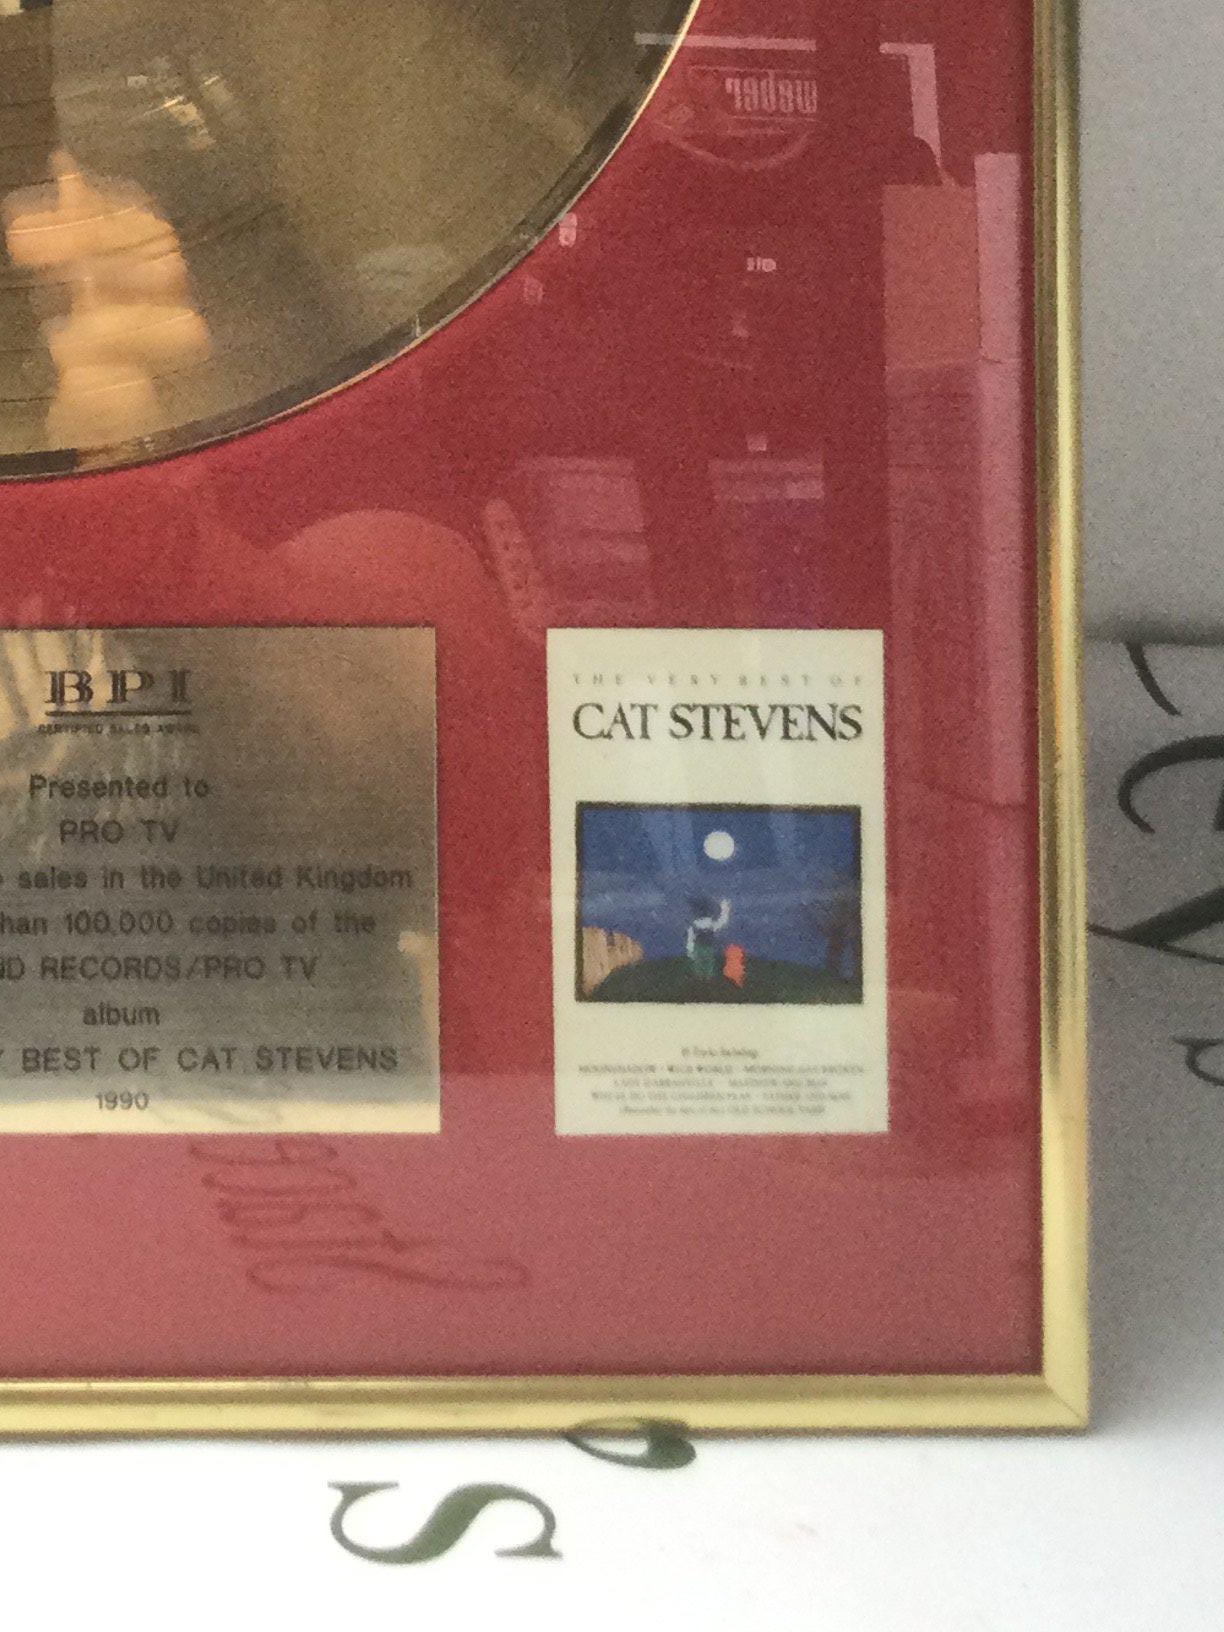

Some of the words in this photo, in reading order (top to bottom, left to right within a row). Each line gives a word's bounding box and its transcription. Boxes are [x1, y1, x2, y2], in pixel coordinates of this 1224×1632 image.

[572, 702, 659, 740] CAT
[669, 702, 864, 741] STEVENS
[29, 774, 168, 799] Presented
[183, 776, 210, 799] to
[60, 821, 123, 844] PRO
[140, 821, 178, 844] TV
[17, 868, 88, 890] sales
[103, 868, 124, 889] in
[141, 868, 182, 890] the
[196, 867, 282, 890] United
[296, 867, 413, 896] Kingdom
[189, 911, 276, 939] copies
[291, 911, 318, 935] of
[333, 911, 376, 934] the
[282, 956, 317, 980] TV
[82, 1003, 160, 1026] album
[22, 1048, 102, 1074] BEST
[118, 1048, 161, 1073] OF
[177, 1048, 238, 1073] CAT
[95, 1092, 150, 1112] 1990
